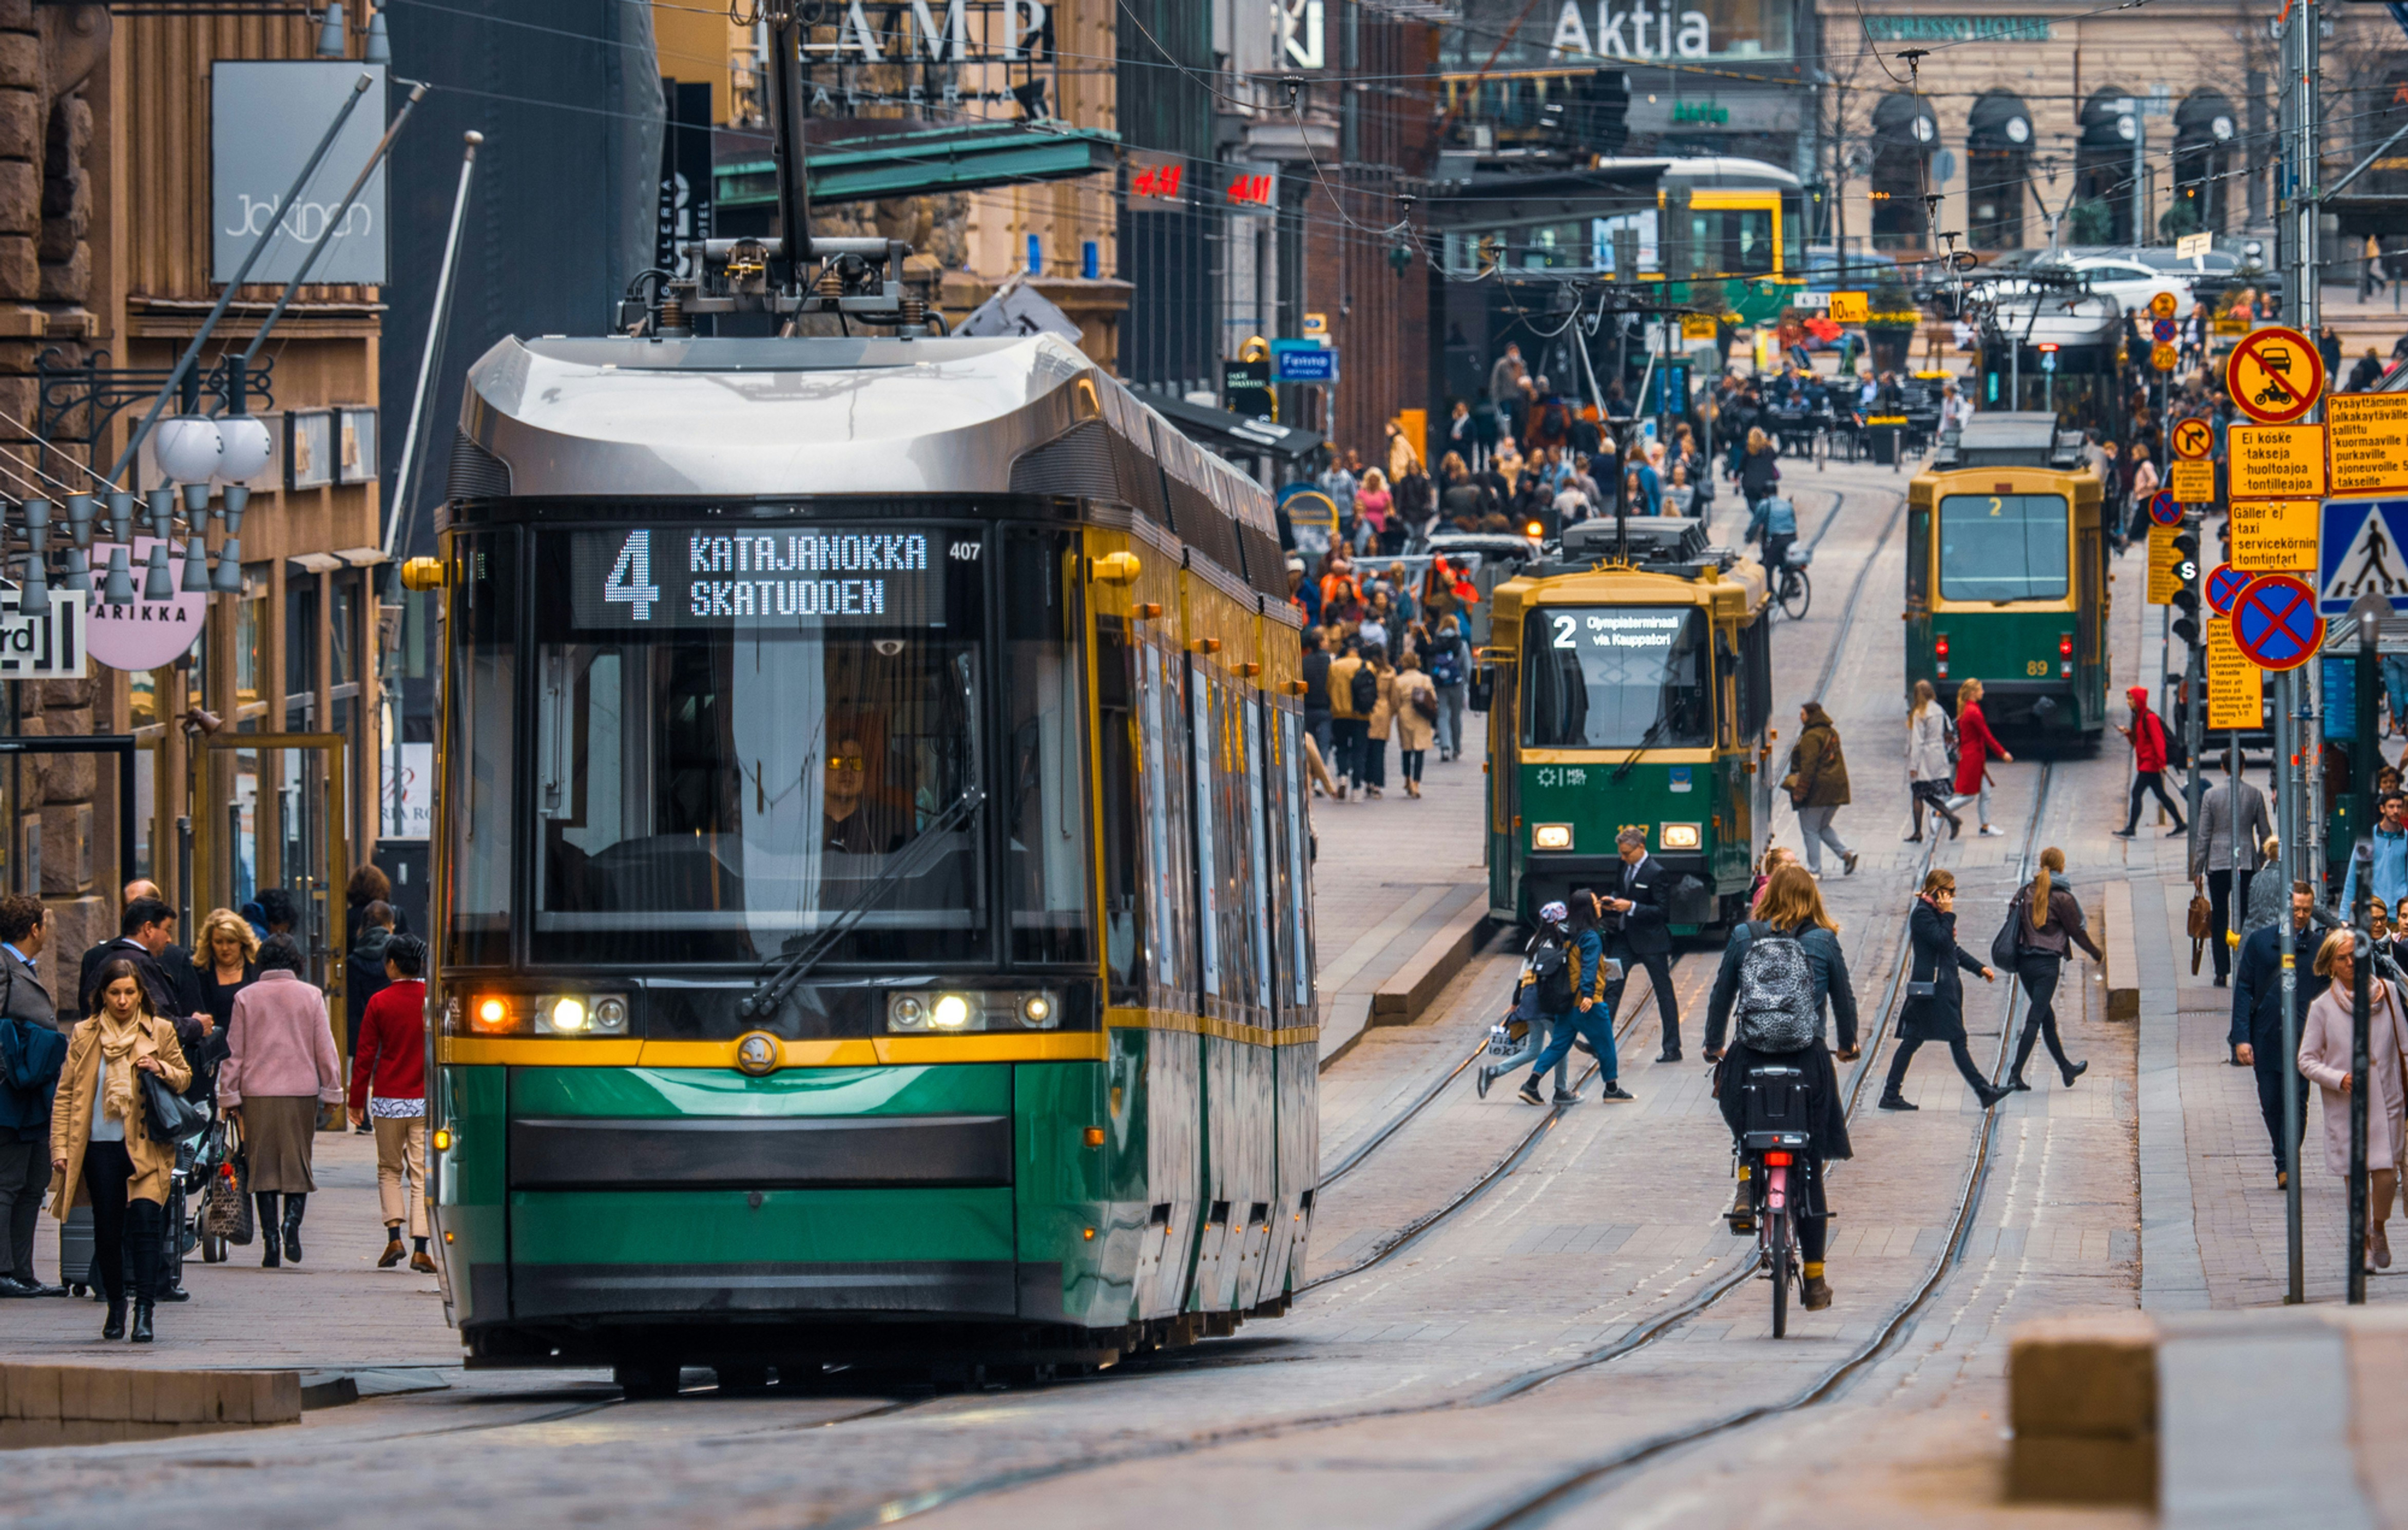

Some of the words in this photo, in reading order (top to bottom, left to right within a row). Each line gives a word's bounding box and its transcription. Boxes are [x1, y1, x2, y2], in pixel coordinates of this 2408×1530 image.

[1549, 0, 1710, 59] Aktia
[1866, 17, 1970, 41] ESPRESSO
[1976, 17, 2050, 41] HOUSE
[811, 84, 1015, 106] ALLERIA
[660, 179, 672, 296] GLLERIA
[1833, 301, 1845, 319] 10
[2158, 350, 2173, 365] 20
[2330, 396, 2406, 410] Pysäyttäminen
[2332, 424, 2367, 435] sallittu
[2242, 433, 2252, 444] Ei
[2258, 432, 2292, 444] koske
[2333, 435, 2401, 448] -kuormaaville
[2243, 448, 2290, 461] -takseja
[2337, 449, 2386, 463] purkaville
[2243, 463, 2308, 476] -huoltoajoa
[2337, 461, 2398, 475] ajoneuvoille
[2243, 478, 2313, 491] -tontilleajoa
[1989, 498, 2002, 517] 2
[2233, 507, 2266, 519] Gäller
[2272, 508, 2283, 521] ej
[2234, 522, 2260, 534] -taxi
[2234, 537, 2317, 550] -servicekörnin
[950, 542, 981, 561] 407
[2234, 553, 2298, 566] -tomtinfart
[604, 529, 659, 621] 4
[690, 534, 927, 572] KATAJANOKKA
[690, 579, 885, 617] SKATUDDEN
[1553, 615, 1577, 648] 2
[1593, 635, 1610, 646] via
[1612, 633, 1670, 648] Kauppatori
[2027, 660, 2048, 676] 89
[1617, 824, 1650, 837] 17
